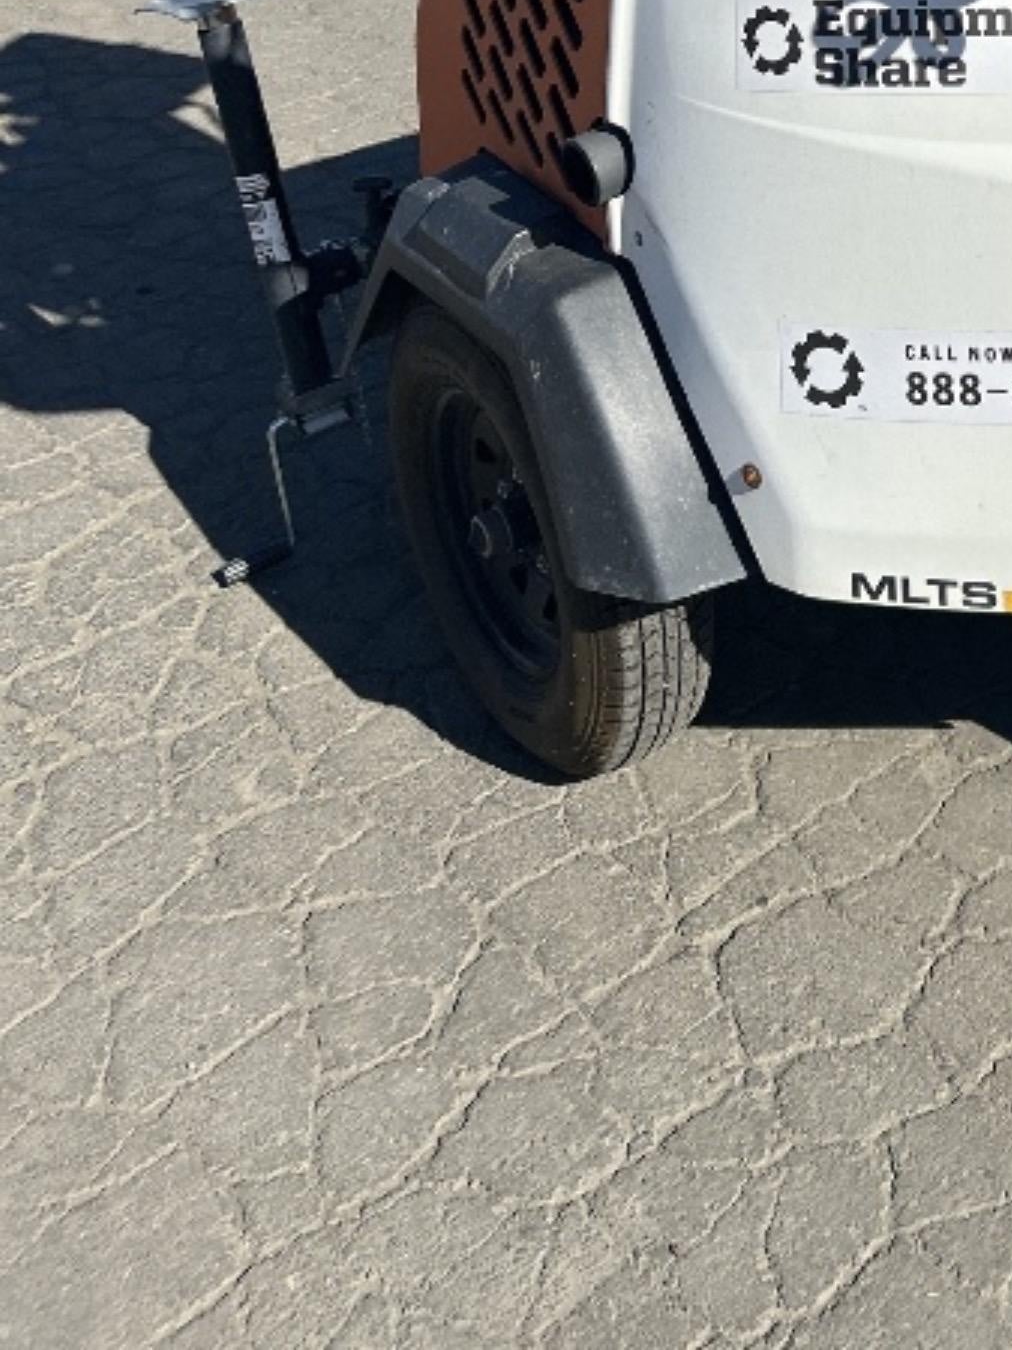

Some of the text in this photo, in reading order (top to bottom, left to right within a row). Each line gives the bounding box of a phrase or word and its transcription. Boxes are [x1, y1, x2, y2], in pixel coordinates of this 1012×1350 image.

[814, 47, 968, 88] Share
[905, 344, 957, 361] CALL
[851, 572, 998, 609] MLTS
